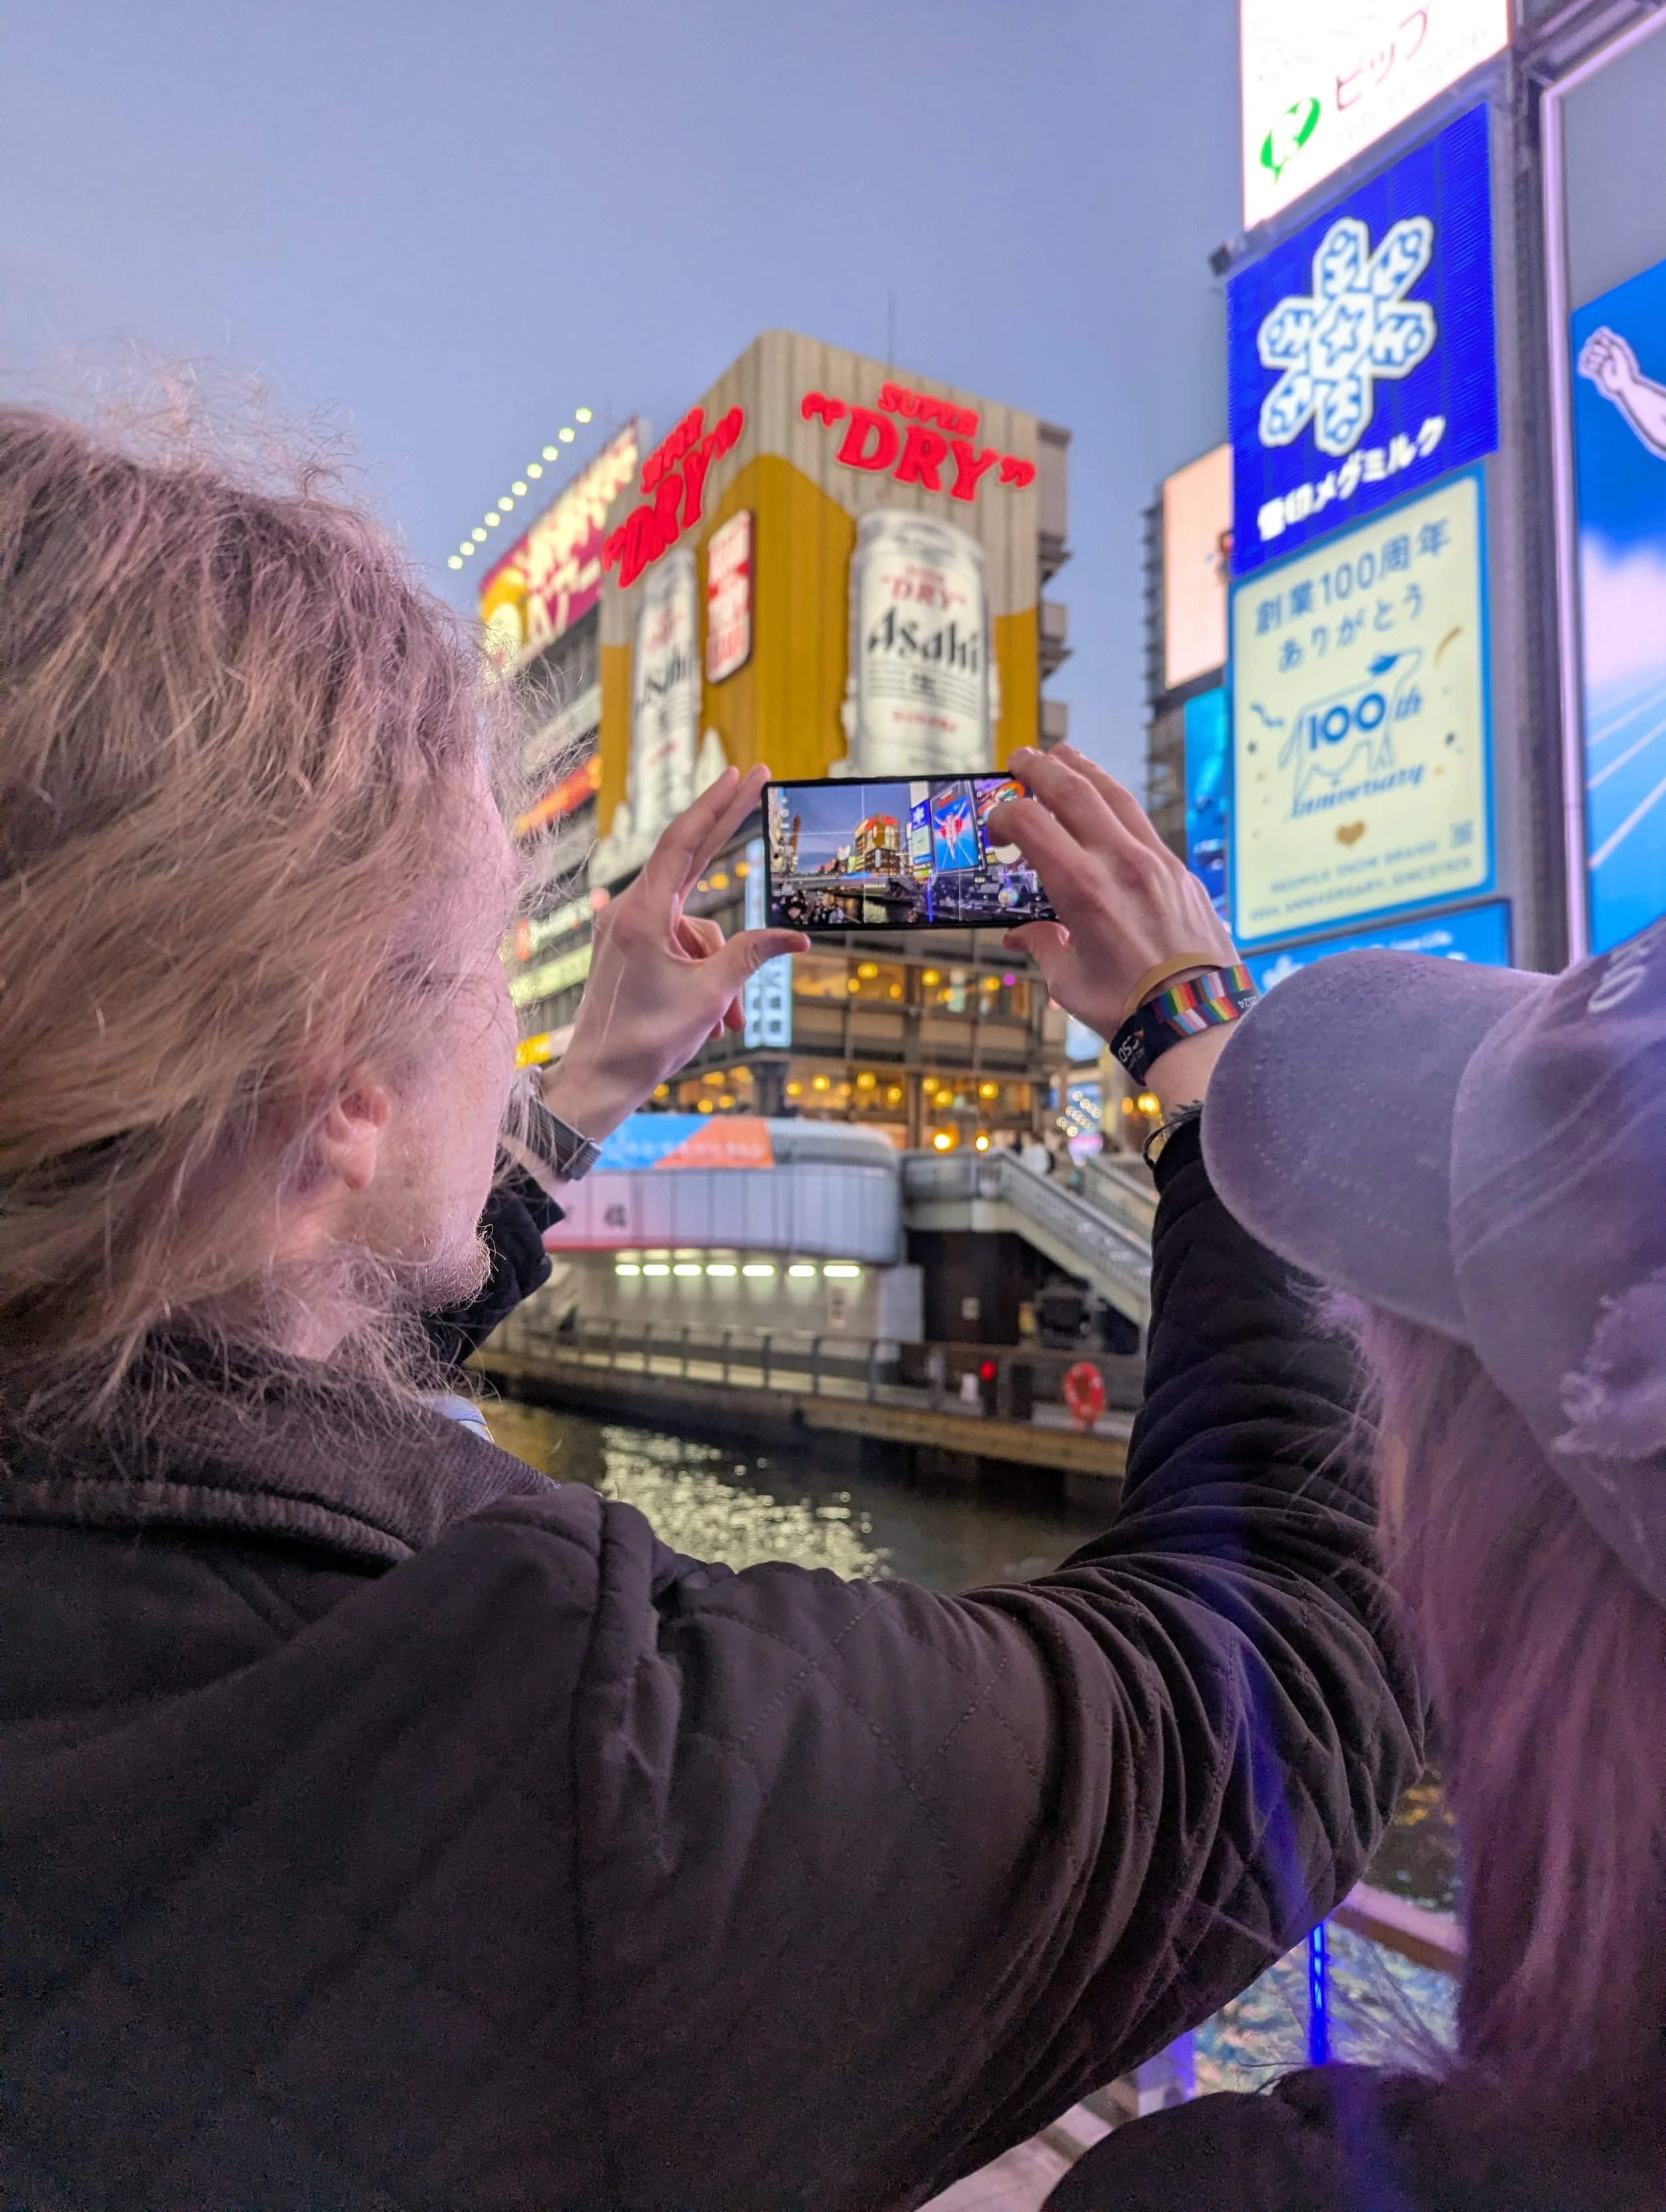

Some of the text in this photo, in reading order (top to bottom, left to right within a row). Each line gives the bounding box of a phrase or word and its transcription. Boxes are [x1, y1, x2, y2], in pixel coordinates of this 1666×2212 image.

[877, 381, 980, 438] SUPER
[1255, 518, 1452, 638] 創業100周年
[868, 605, 980, 676] Asahi
[1278, 583, 1423, 673] ありがとう
[1118, 1036, 1140, 1063] CSD
